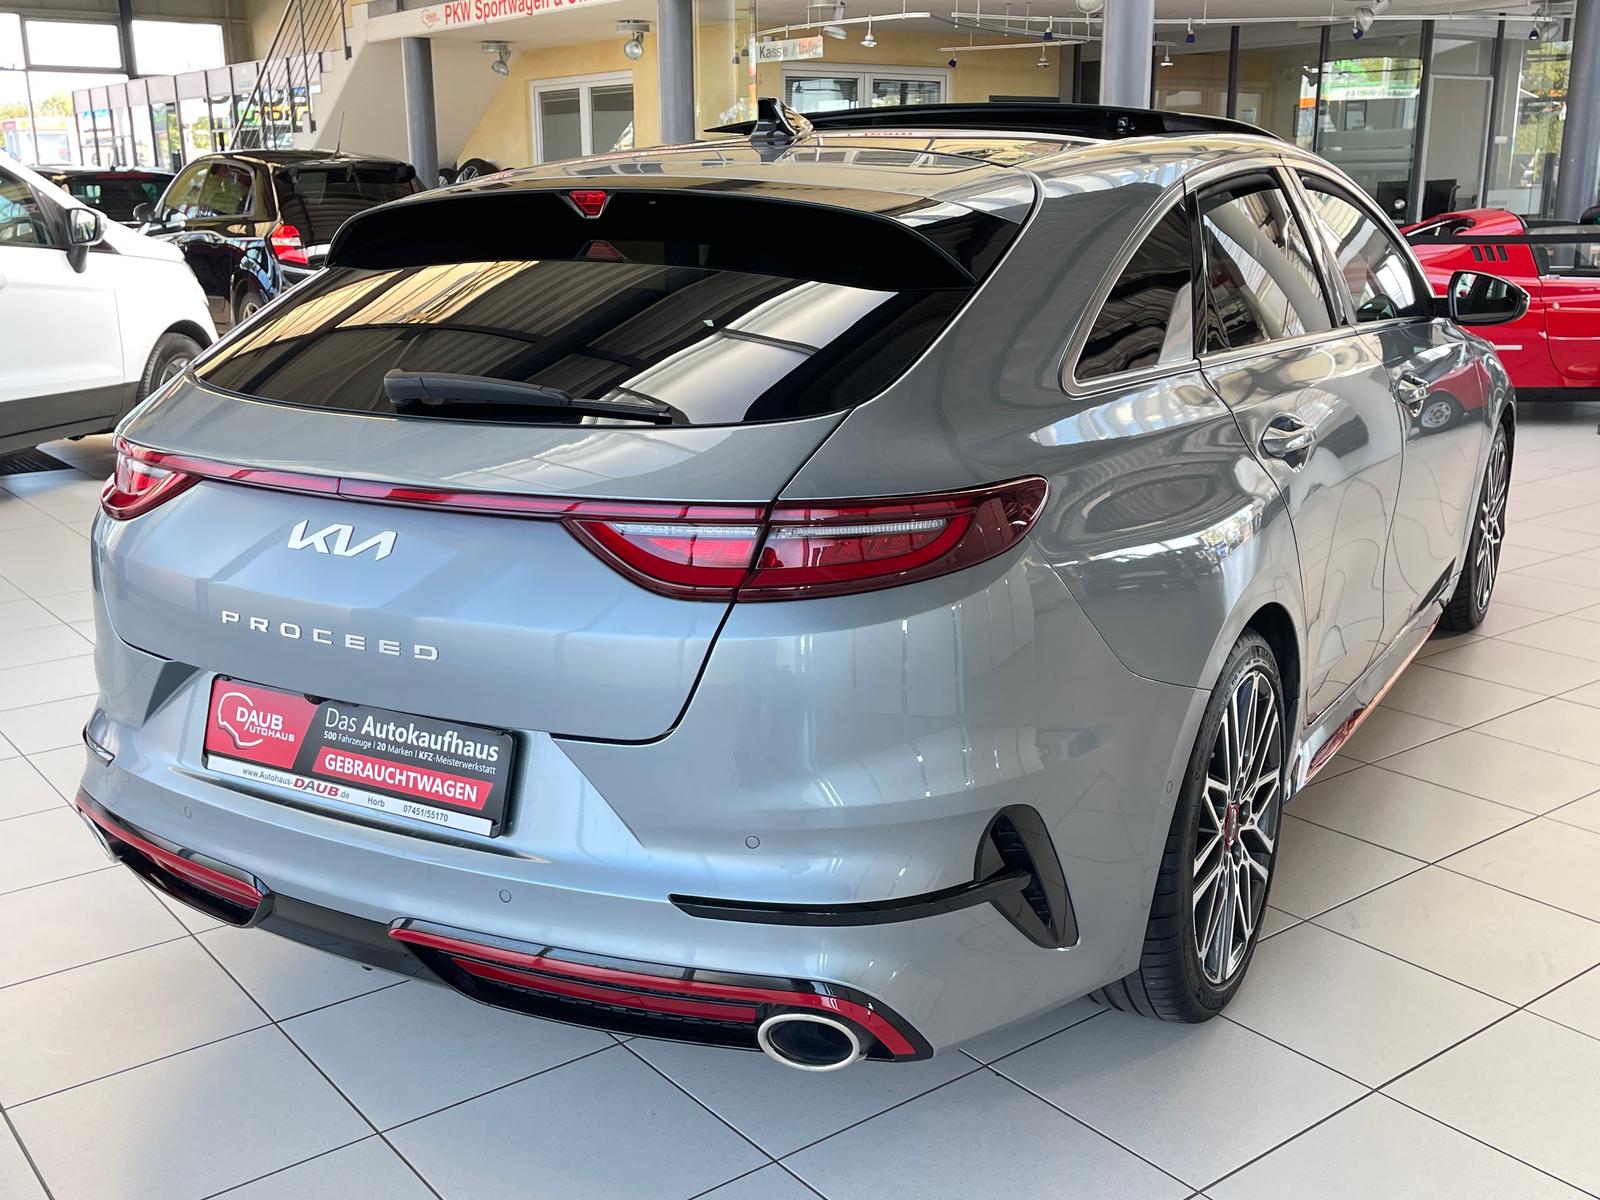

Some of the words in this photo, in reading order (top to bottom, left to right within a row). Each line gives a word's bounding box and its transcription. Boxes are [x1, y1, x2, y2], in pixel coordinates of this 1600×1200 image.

[444, 3, 471, 25] PKW
[475, 0, 549, 23] Sportwagen
[760, 45, 788, 59] Kasse
[221, 610, 439, 661] PROCEED
[236, 706, 283, 731] DAUB
[325, 707, 357, 732] Das
[361, 715, 499, 762] Autokaufhaus
[323, 730, 337, 741] 500
[338, 734, 372, 749] Fahrzeuge
[376, 743, 386, 752] 20
[387, 744, 414, 758] Marken
[418, 750, 496, 775] KFZ-Meisterwerkstatt
[325, 753, 478, 802] GEBRAUCHTWAGEN
[367, 796, 386, 808] Horb
[403, 804, 449, 822] 07451/55170
